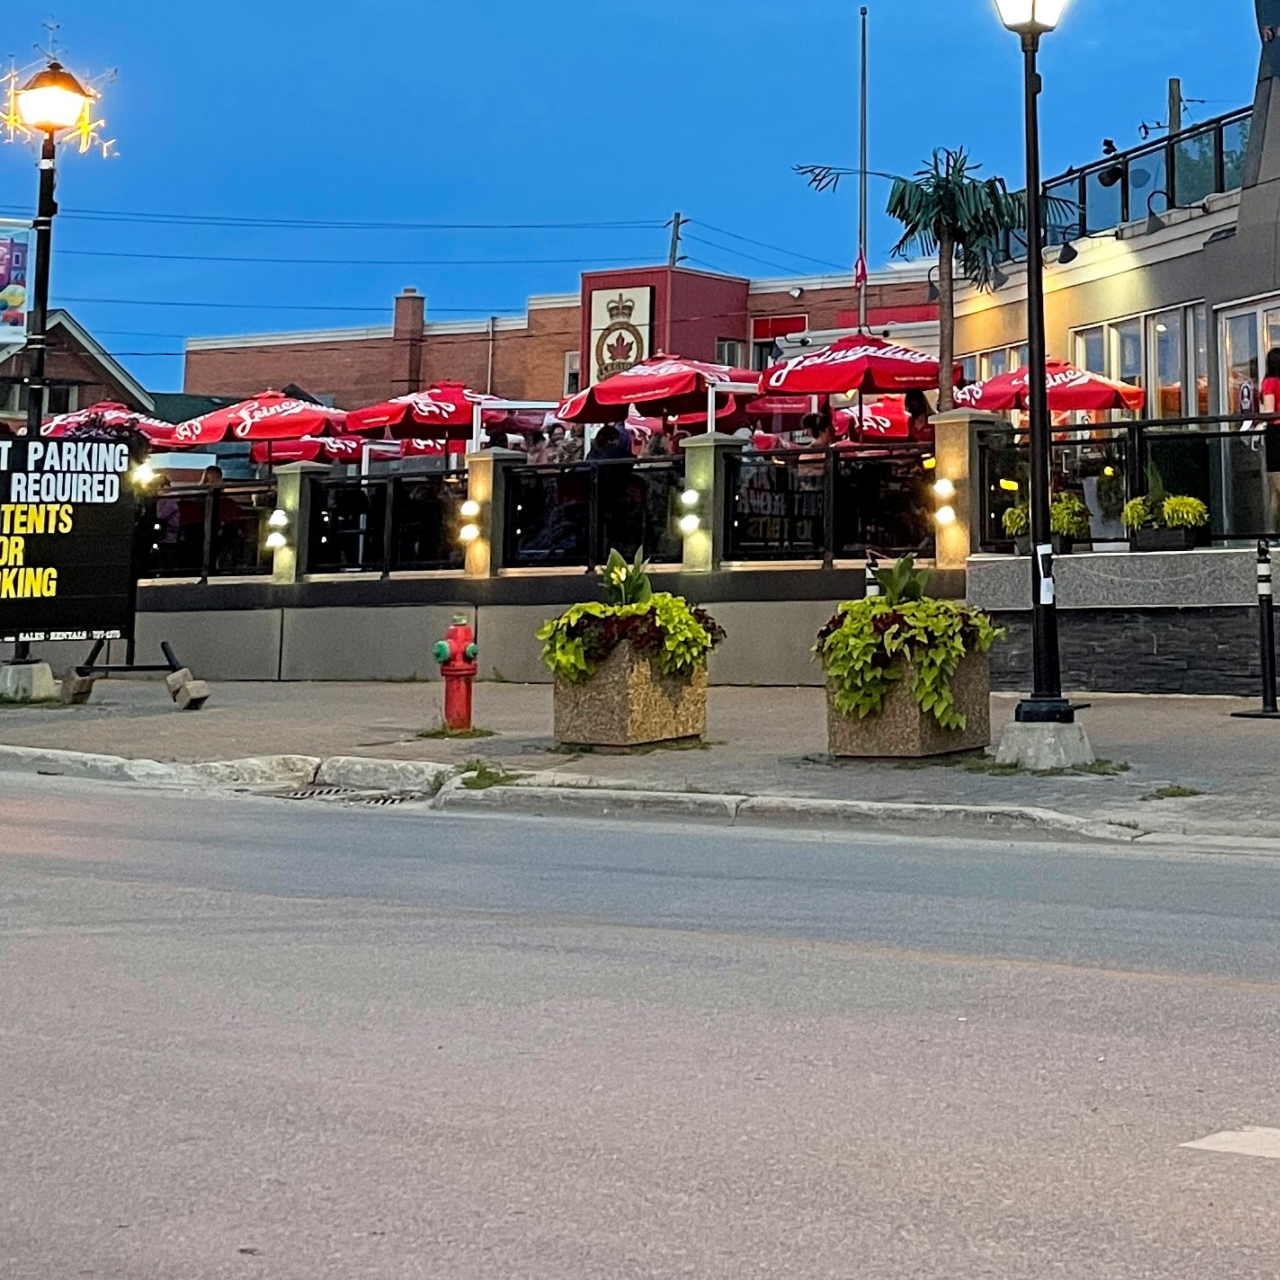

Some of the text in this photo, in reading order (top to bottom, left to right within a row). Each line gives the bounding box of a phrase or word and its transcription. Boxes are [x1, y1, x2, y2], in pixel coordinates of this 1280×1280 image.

[28, 441, 129, 472] PARKING
[11, 473, 120, 503] REQUIRED
[1, 504, 73, 534] TENTS
[0, 567, 58, 598] KING
[50, 631, 87, 640] RENTALS
